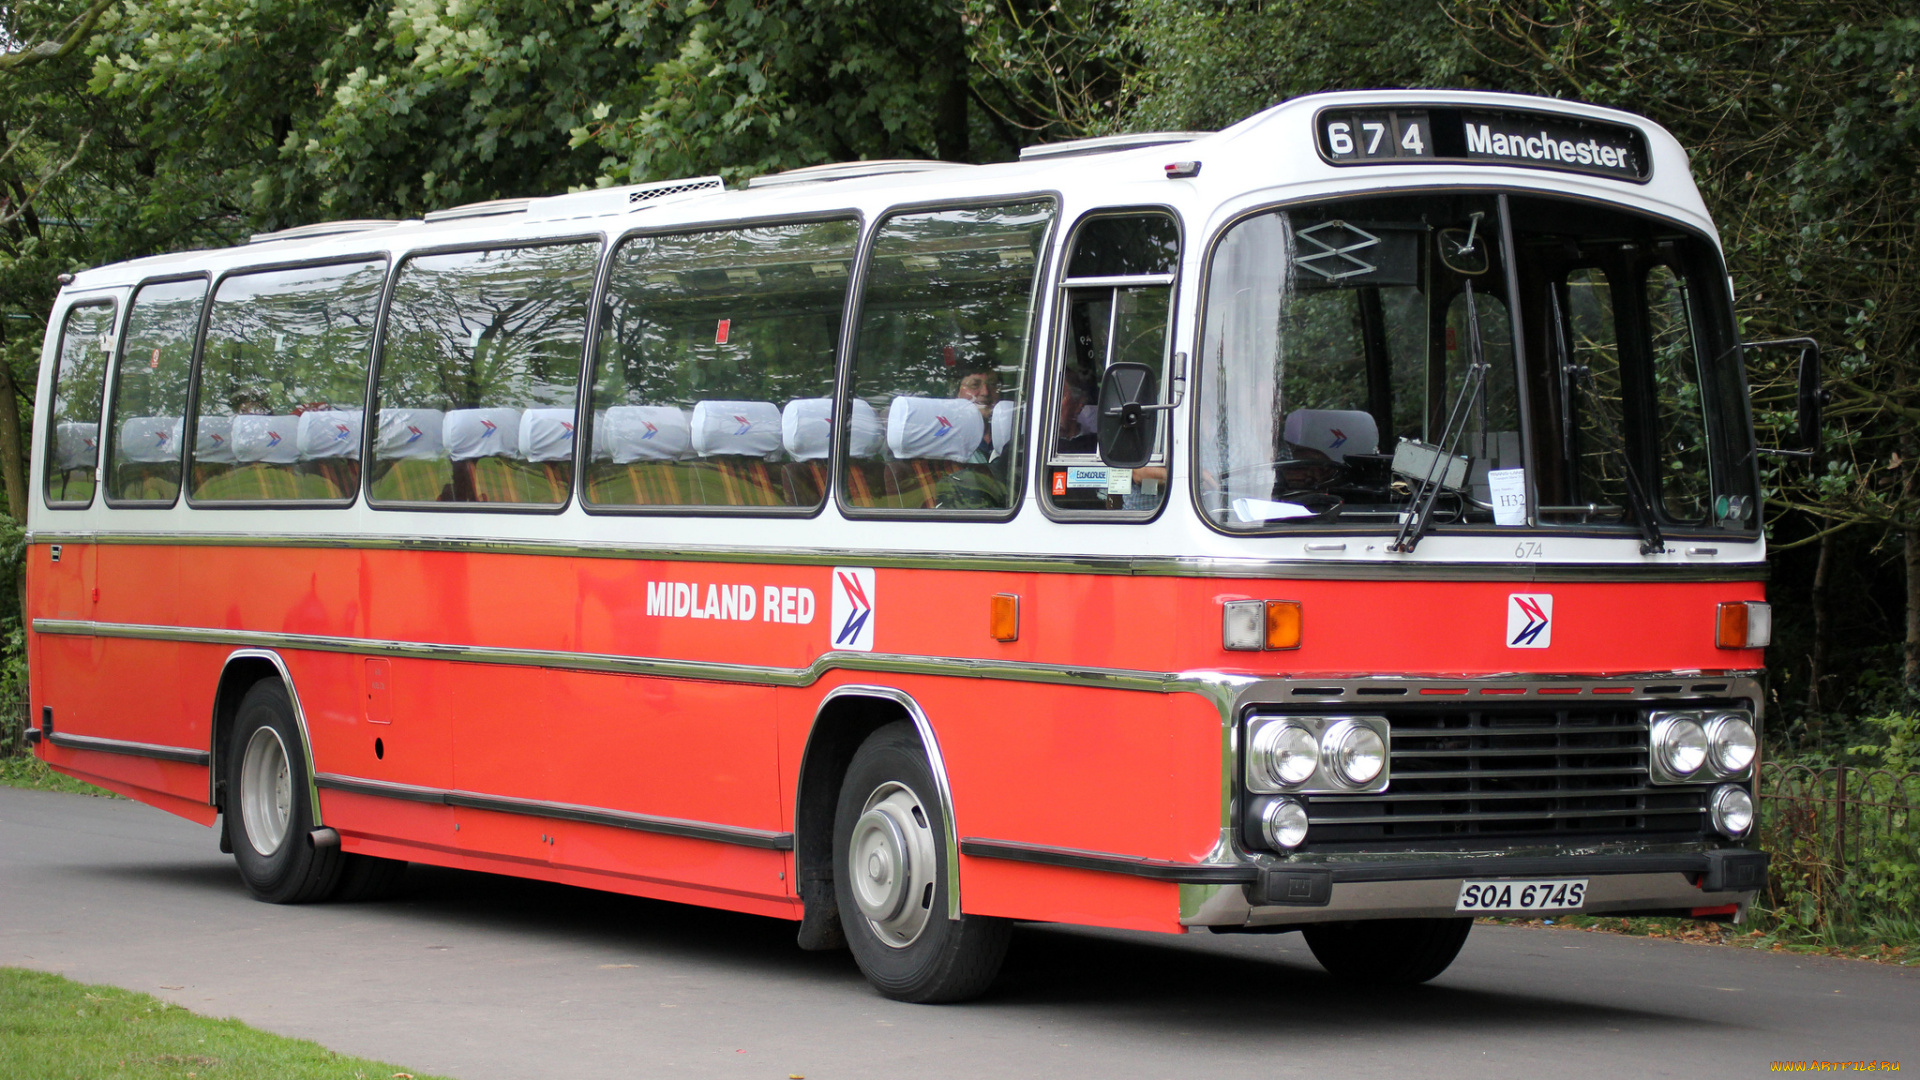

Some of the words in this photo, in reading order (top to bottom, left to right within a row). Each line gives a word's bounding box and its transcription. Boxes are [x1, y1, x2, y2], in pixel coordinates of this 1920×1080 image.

[1327, 122, 1424, 155] 674
[1464, 122, 1627, 168] Manchester
[1055, 478, 1064, 490] A
[1500, 493, 1525, 507] H32
[1514, 541, 1543, 559] 674
[646, 581, 757, 621] MIDLAND
[763, 585, 815, 625] RED
[1463, 884, 1511, 908] SOA
[1520, 883, 1584, 908] 674S
